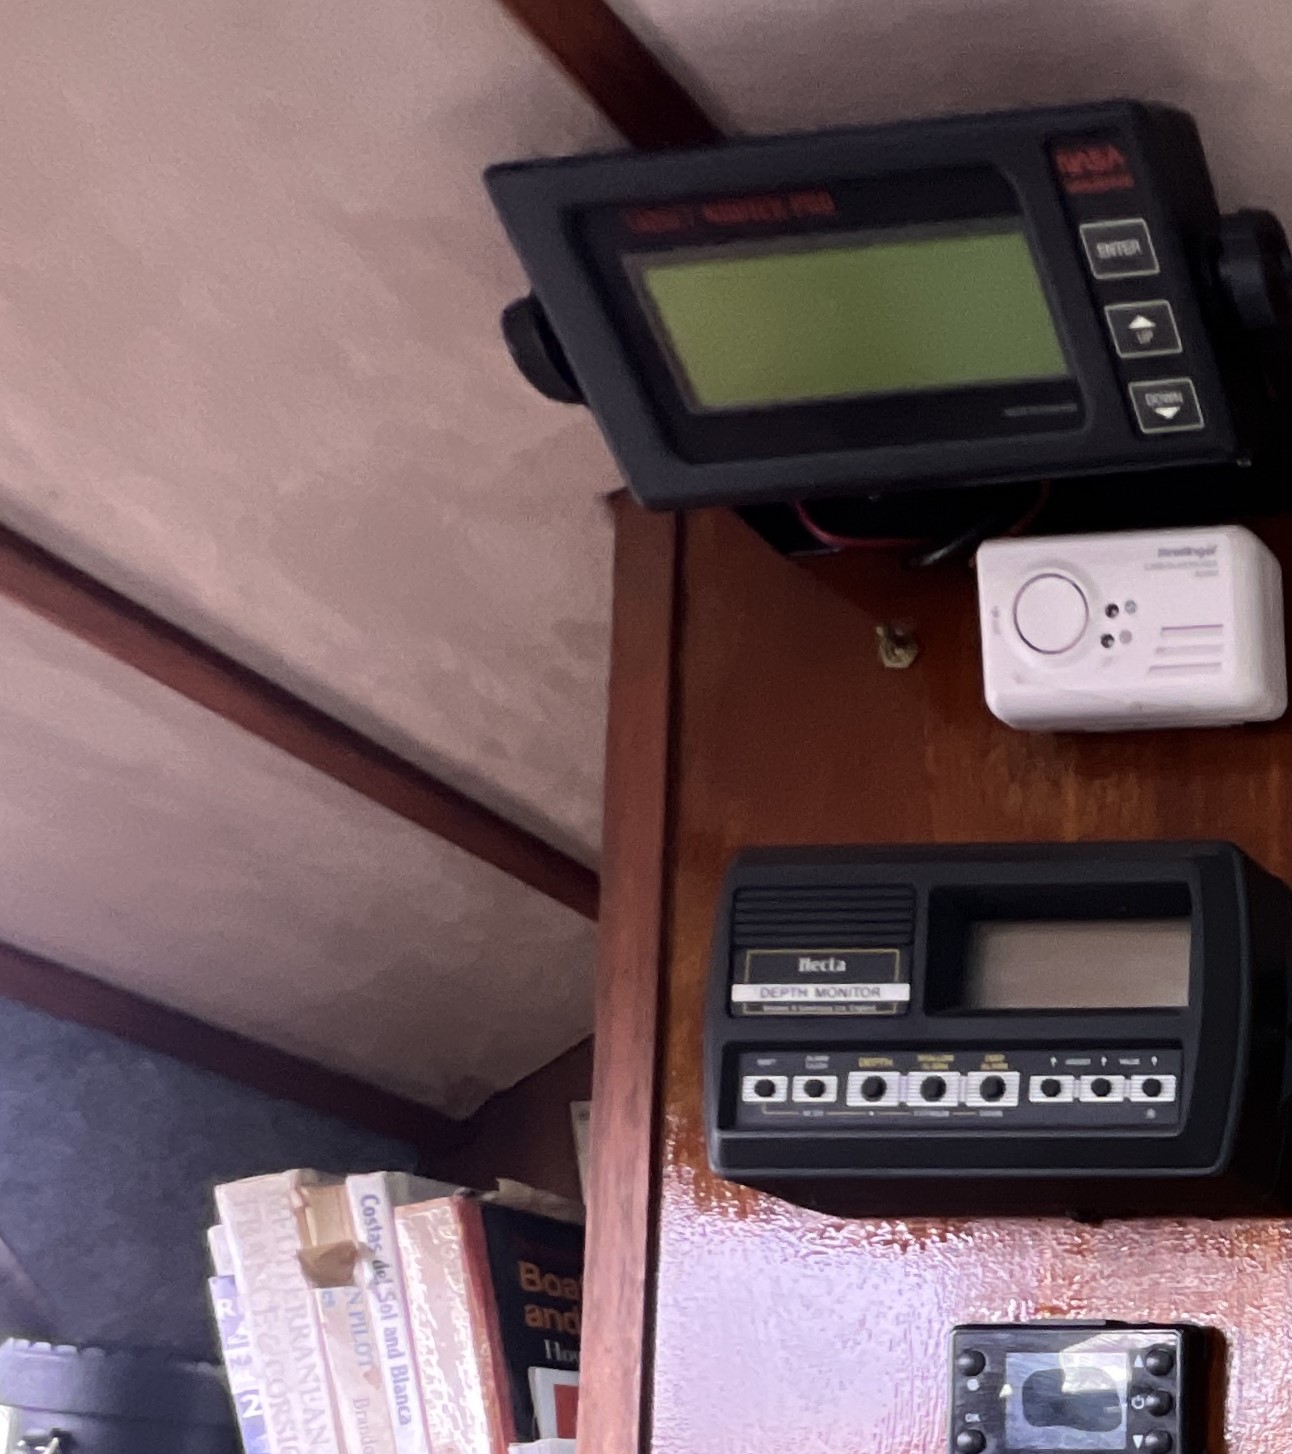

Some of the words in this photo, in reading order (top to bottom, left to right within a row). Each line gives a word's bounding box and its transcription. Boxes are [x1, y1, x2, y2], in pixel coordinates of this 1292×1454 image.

[1096, 239, 1143, 259] ENTER
[760, 986, 808, 998] DEPTH
[814, 986, 881, 998] MONITOR
[360, 1193, 383, 1253] Costas
[372, 1259, 392, 1287] del
[518, 1260, 582, 1300] Boa
[376, 1287, 398, 1321] Sol
[524, 1304, 582, 1336] and
[350, 1310, 374, 1368] PILOT
[384, 1327, 405, 1361] and
[390, 1364, 413, 1427] Blanca
